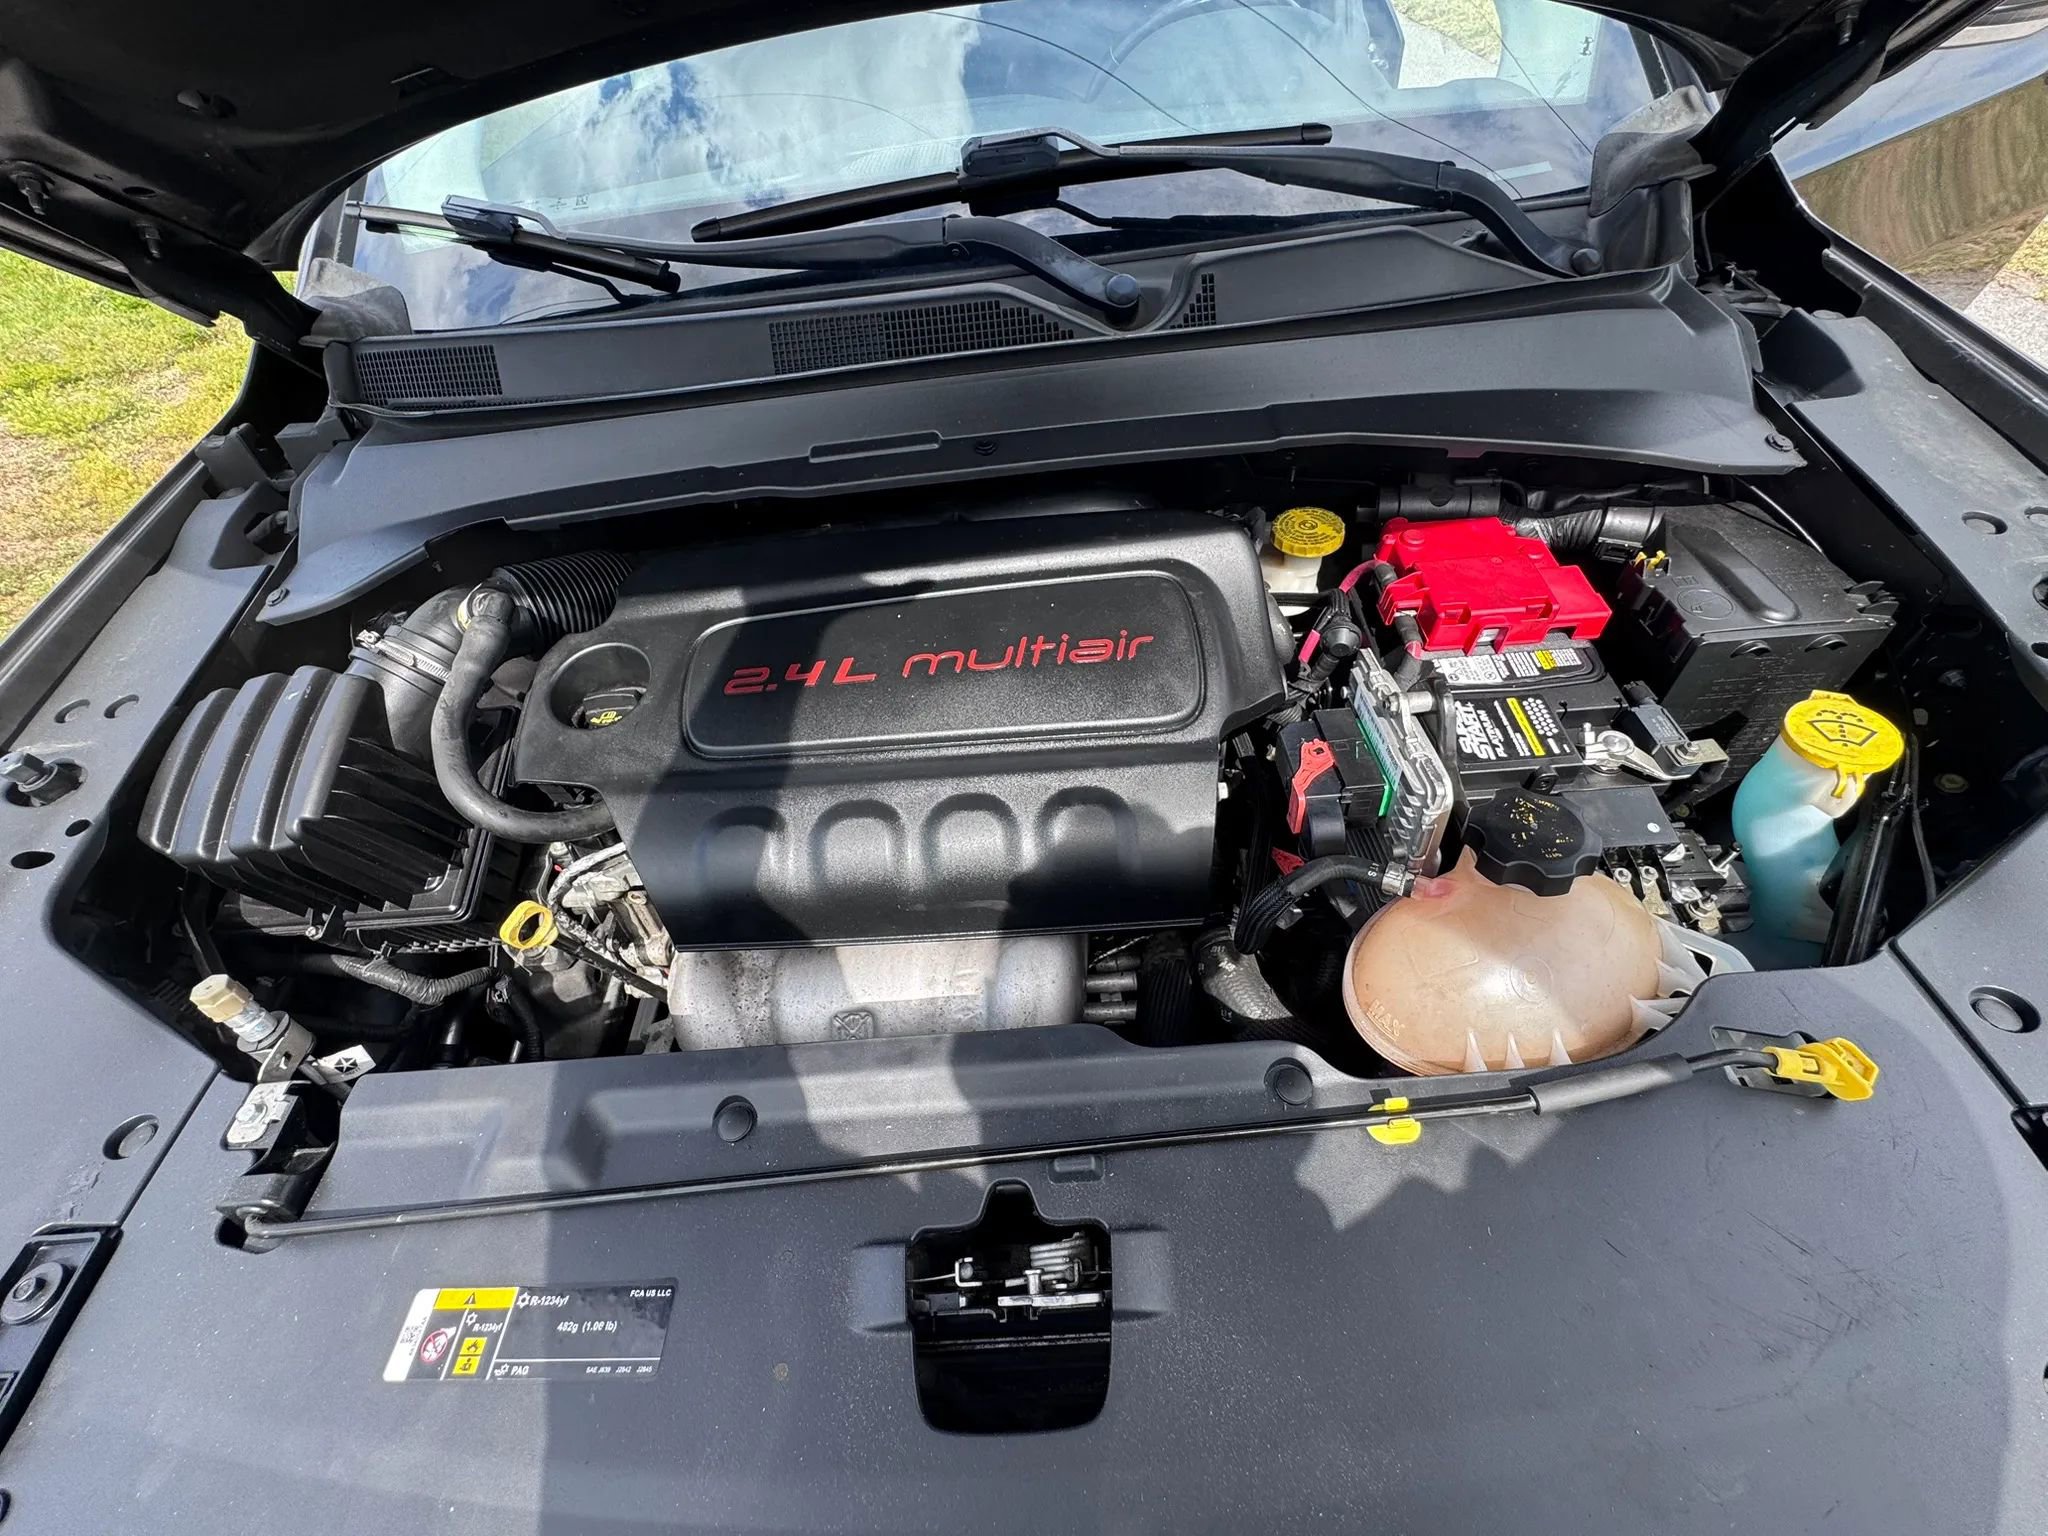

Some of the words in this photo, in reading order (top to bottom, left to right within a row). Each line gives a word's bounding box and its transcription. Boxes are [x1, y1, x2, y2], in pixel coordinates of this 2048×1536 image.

[723, 656, 877, 696] 2.4L
[902, 629, 1154, 677] multiair
[629, 1288, 645, 1298] FCA
[645, 1288, 657, 1297] US
[656, 1288, 672, 1297] LLC
